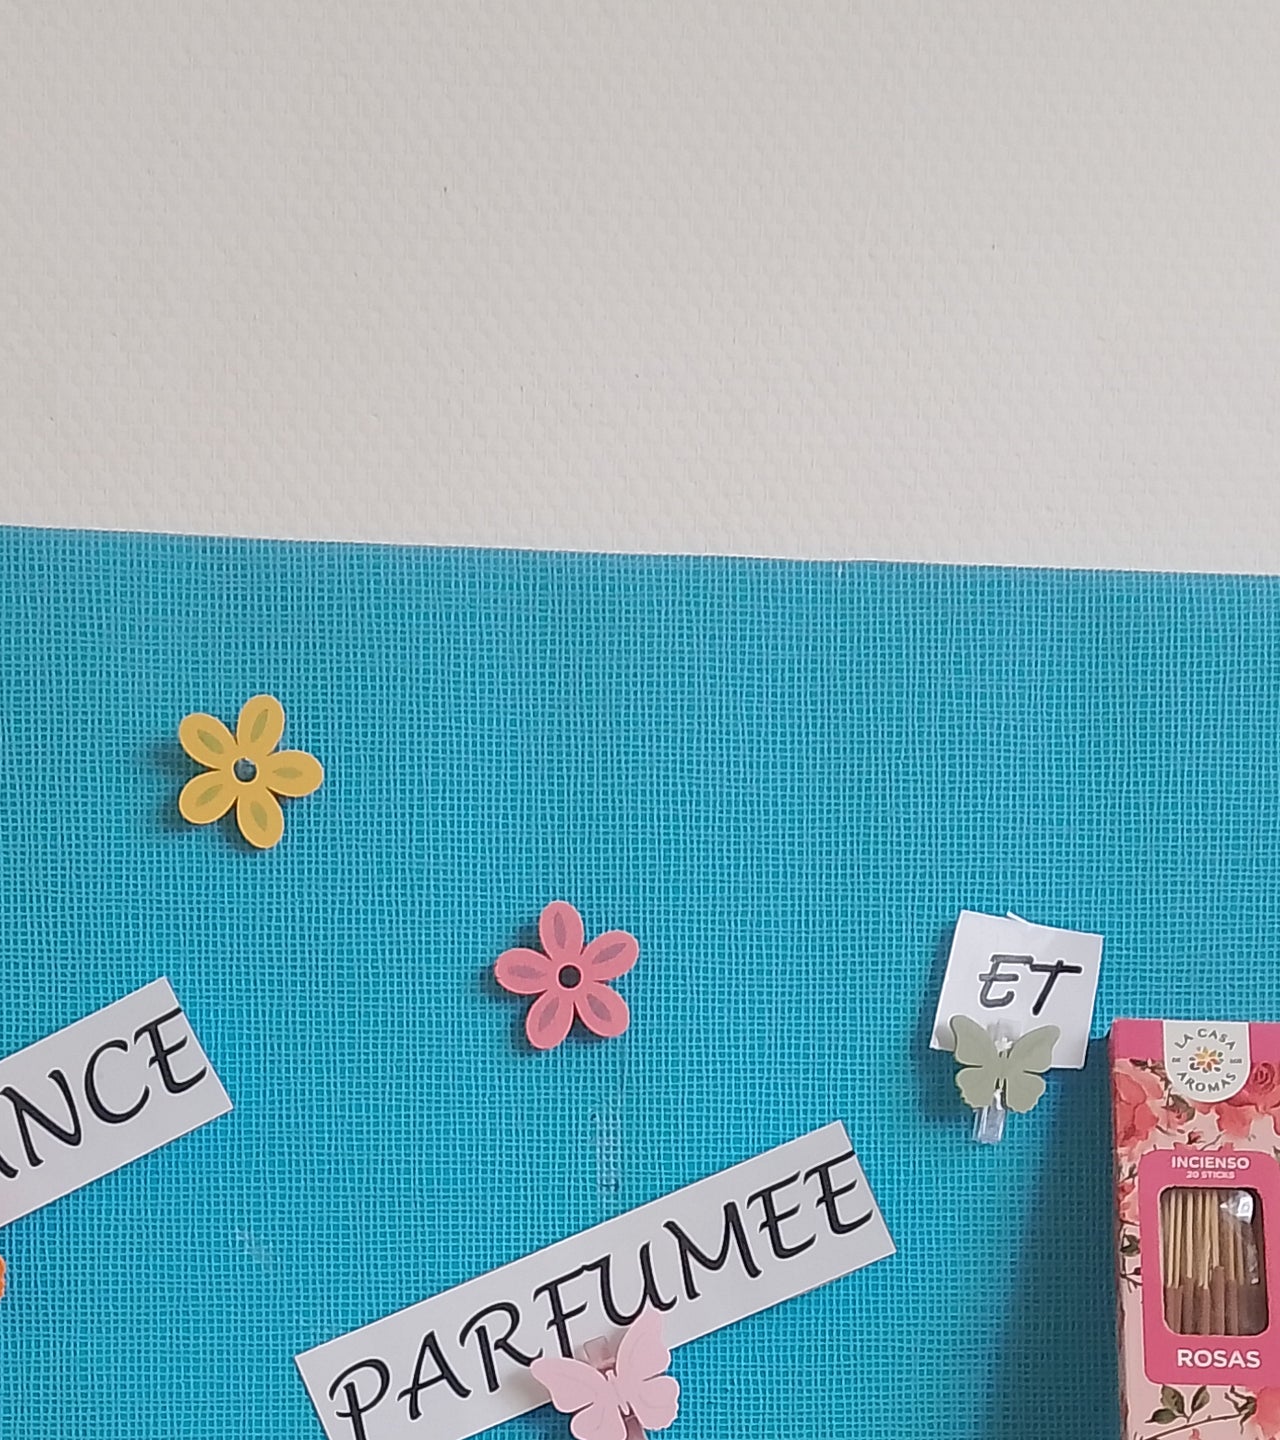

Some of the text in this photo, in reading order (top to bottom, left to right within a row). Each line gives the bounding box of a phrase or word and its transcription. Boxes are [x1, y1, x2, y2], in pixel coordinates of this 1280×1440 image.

[978, 954, 1082, 1016] ET
[1174, 1028, 1236, 1051] LA CASA
[1177, 1072, 1237, 1093] AROMAS
[1171, 1156, 1250, 1170] INCIENSO
[1186, 1171, 1236, 1179] 20 STICKS
[1176, 1349, 1262, 1369] ROSAS
